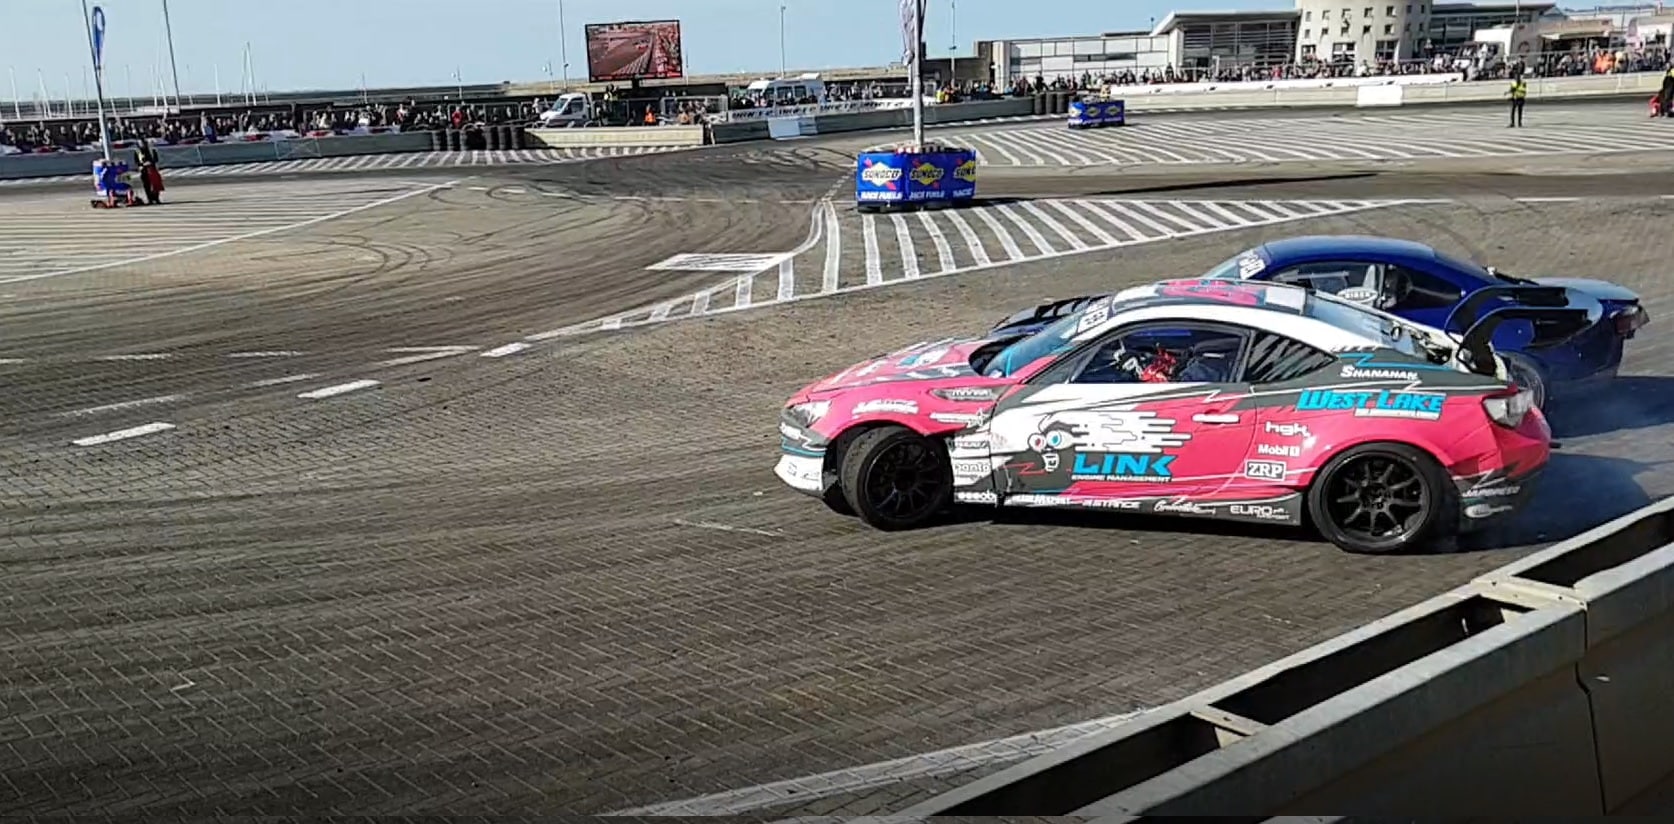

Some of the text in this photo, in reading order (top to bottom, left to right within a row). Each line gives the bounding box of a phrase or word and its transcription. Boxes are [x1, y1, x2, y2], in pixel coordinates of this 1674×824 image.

[863, 169, 900, 179] SUNOCO
[1340, 364, 1418, 381] SHANAHAN
[1297, 388, 1445, 413] WEST LAKE
[1258, 444, 1289, 456] Mobil
[1073, 452, 1177, 475] LINK
[1248, 462, 1283, 478] ZRP
[1230, 504, 1272, 516] EURO
